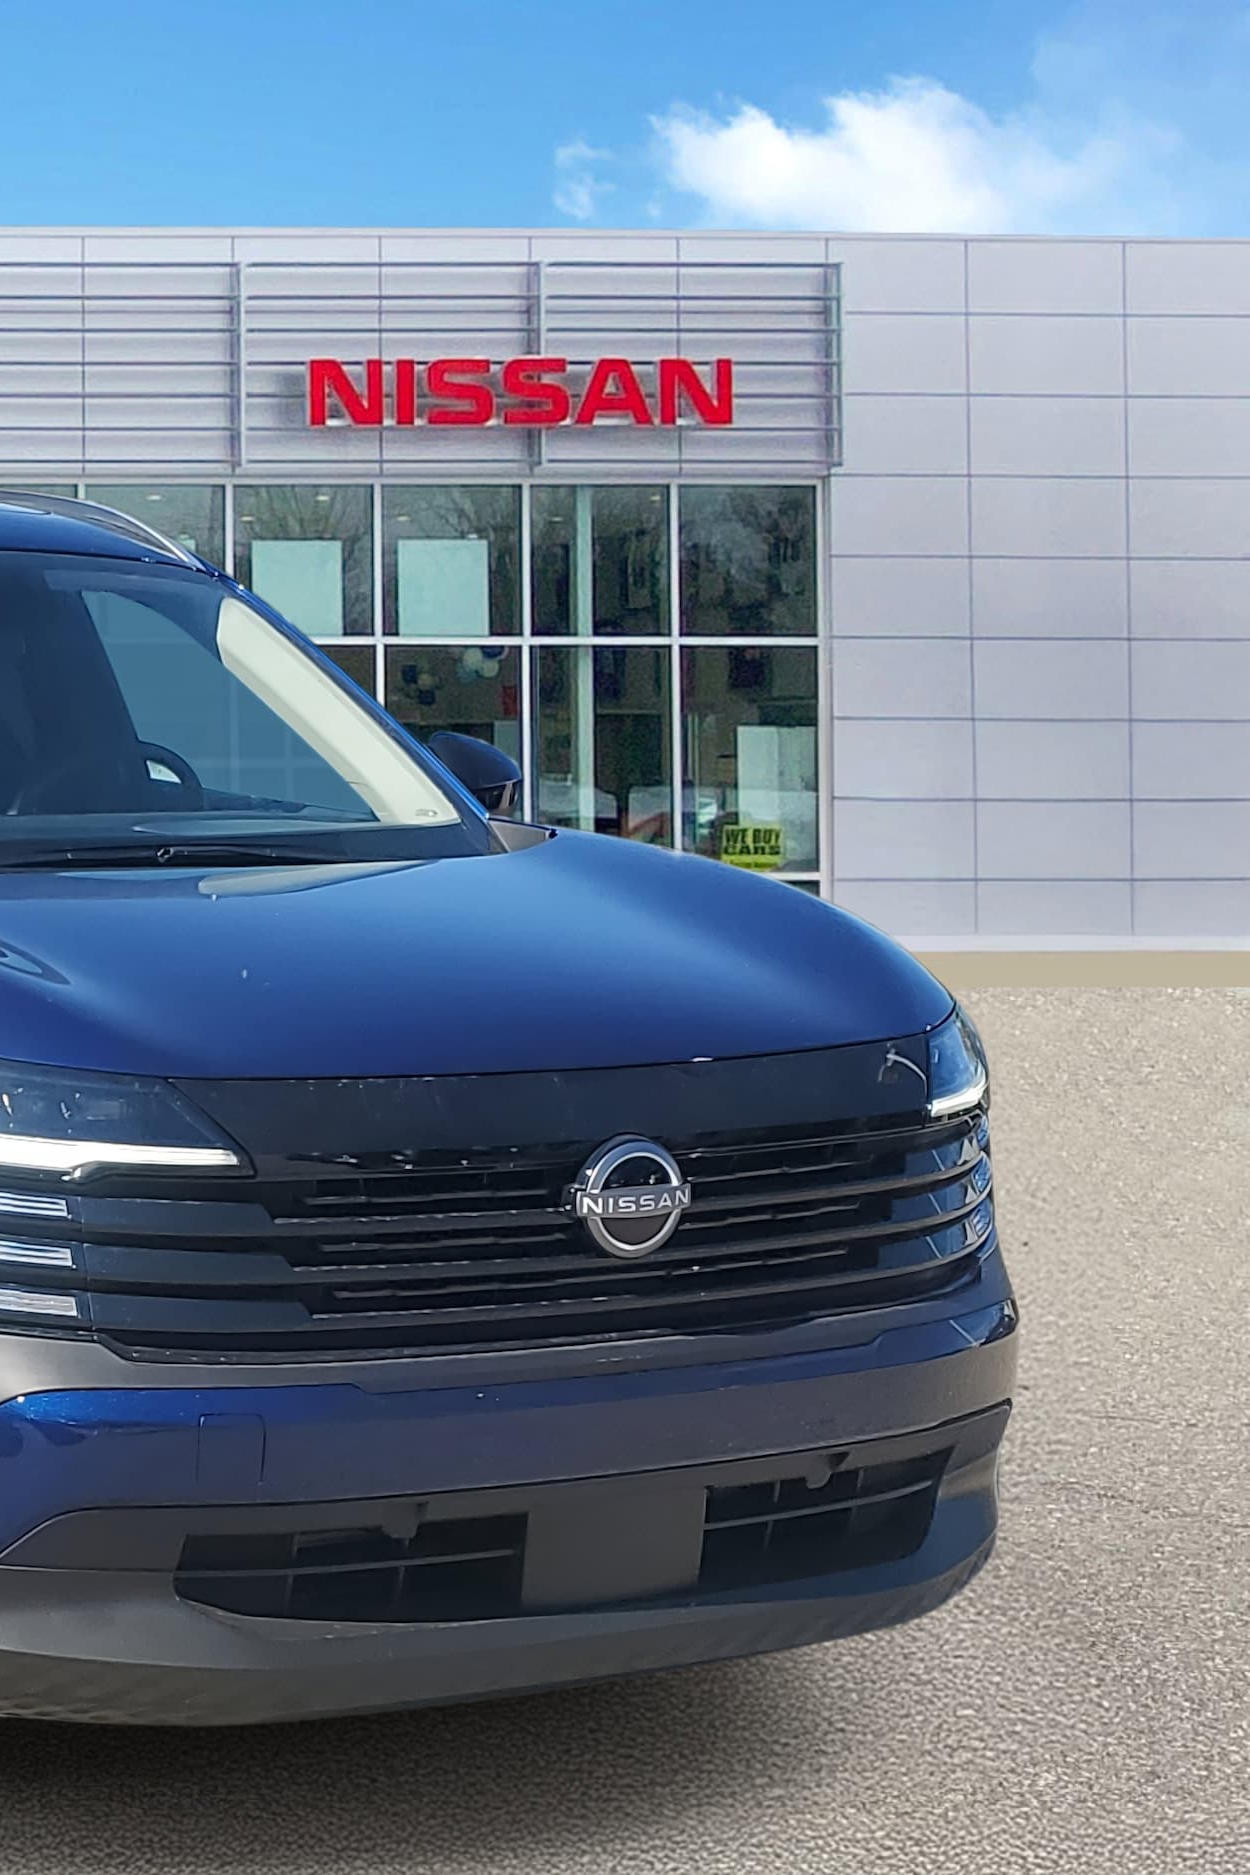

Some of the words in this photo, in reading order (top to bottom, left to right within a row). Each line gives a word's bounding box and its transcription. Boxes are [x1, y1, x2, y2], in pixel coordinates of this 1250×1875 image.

[308, 357, 734, 426] NISSAN
[726, 829, 748, 844] WE
[753, 829, 782, 844] BUY
[724, 845, 781, 855] CARS
[582, 1187, 689, 1214] NISSAN
